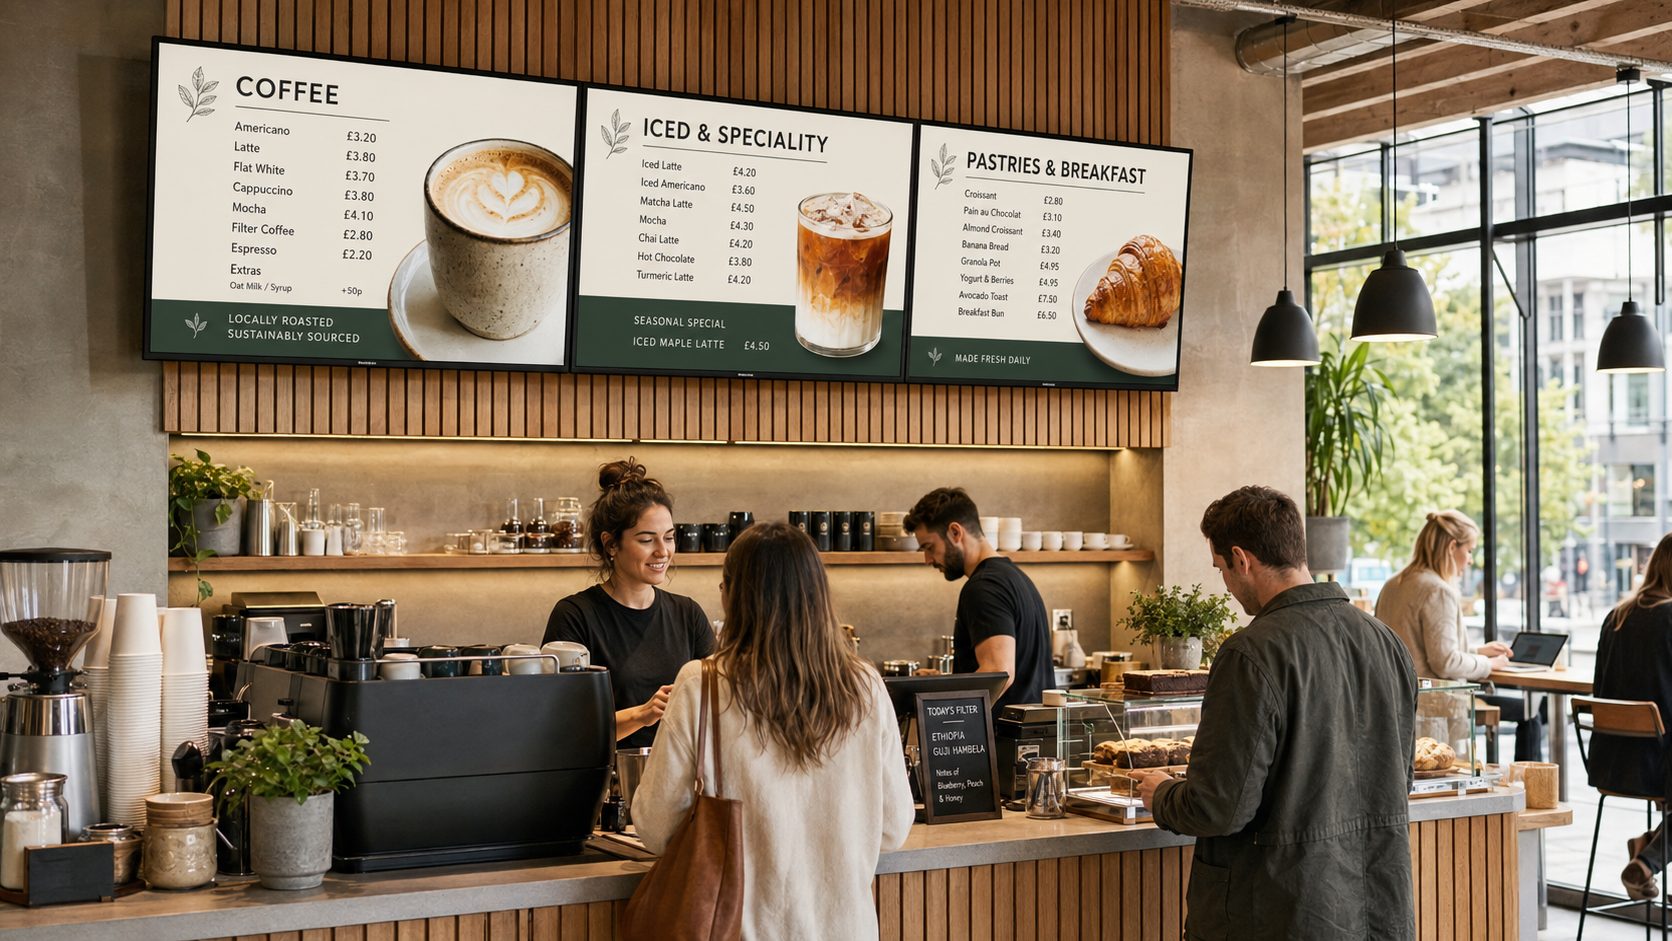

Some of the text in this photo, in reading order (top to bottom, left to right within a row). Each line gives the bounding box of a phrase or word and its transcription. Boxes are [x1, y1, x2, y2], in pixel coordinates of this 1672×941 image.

[236, 76, 338, 105] COFFEE
[235, 121, 376, 143] Americano £3.20
[644, 118, 828, 153] ICED & SPECIALITY
[235, 141, 375, 162] Latte £3.80
[234, 161, 375, 182] Flat White £3.70
[642, 159, 756, 177] Iced Latte £4.20
[967, 152, 1146, 184] PASTRIES & BREAKFAST
[233, 182, 374, 201] Cappuccino £3.80
[641, 177, 755, 195] Iced Americano £3.60
[640, 196, 754, 213] Matcha Latte £4.50
[964, 189, 1063, 205] Croissant £2.80
[233, 202, 373, 221] Mocha £4.10
[964, 206, 979, 215] Pain
[990, 208, 1021, 219] Chocolat
[1043, 212, 1062, 222] £3.10
[640, 215, 753, 231] Mocha £4.30
[962, 223, 1061, 238] Almond Croissant £3.40
[232, 222, 373, 240] Filter Coffee £2.80
[639, 233, 753, 249] Chai Latte £4.20
[962, 240, 1060, 254] Banana Bread £3.20
[232, 242, 372, 260] Espresso £2.20
[638, 252, 752, 267] Hot Chocolate £3.80
[961, 257, 1059, 271] Granola Pot £4.95
[231, 264, 261, 275] Extras
[637, 270, 751, 284] Turmeric Latte £4.20
[960, 274, 1058, 287] Yogurt & Berries £4.95
[230, 281, 362, 296] Oat Milk / Syrup +50p
[959, 291, 1057, 303] Avocado Toast £7.50
[229, 314, 333, 327] LOCALLY ROASTED
[958, 307, 1056, 320] Breakfast Bun £6.50
[634, 316, 725, 328] SEASONAL SPECIAL
[228, 329, 360, 343] SUSTAINABLY SOURCED
[633, 337, 769, 350] ICED MAPLE LATTE £4.50
[955, 354, 1030, 364] MADE FRESH DAILY
[927, 705, 978, 716] TODAY'S FILTER
[932, 731, 965, 741] ETHIOPIA
[933, 745, 985, 756] GUJI HAMBELA
[953, 768, 959, 776] of
[967, 779, 983, 787] Peach
[939, 795, 963, 803] & Honey
